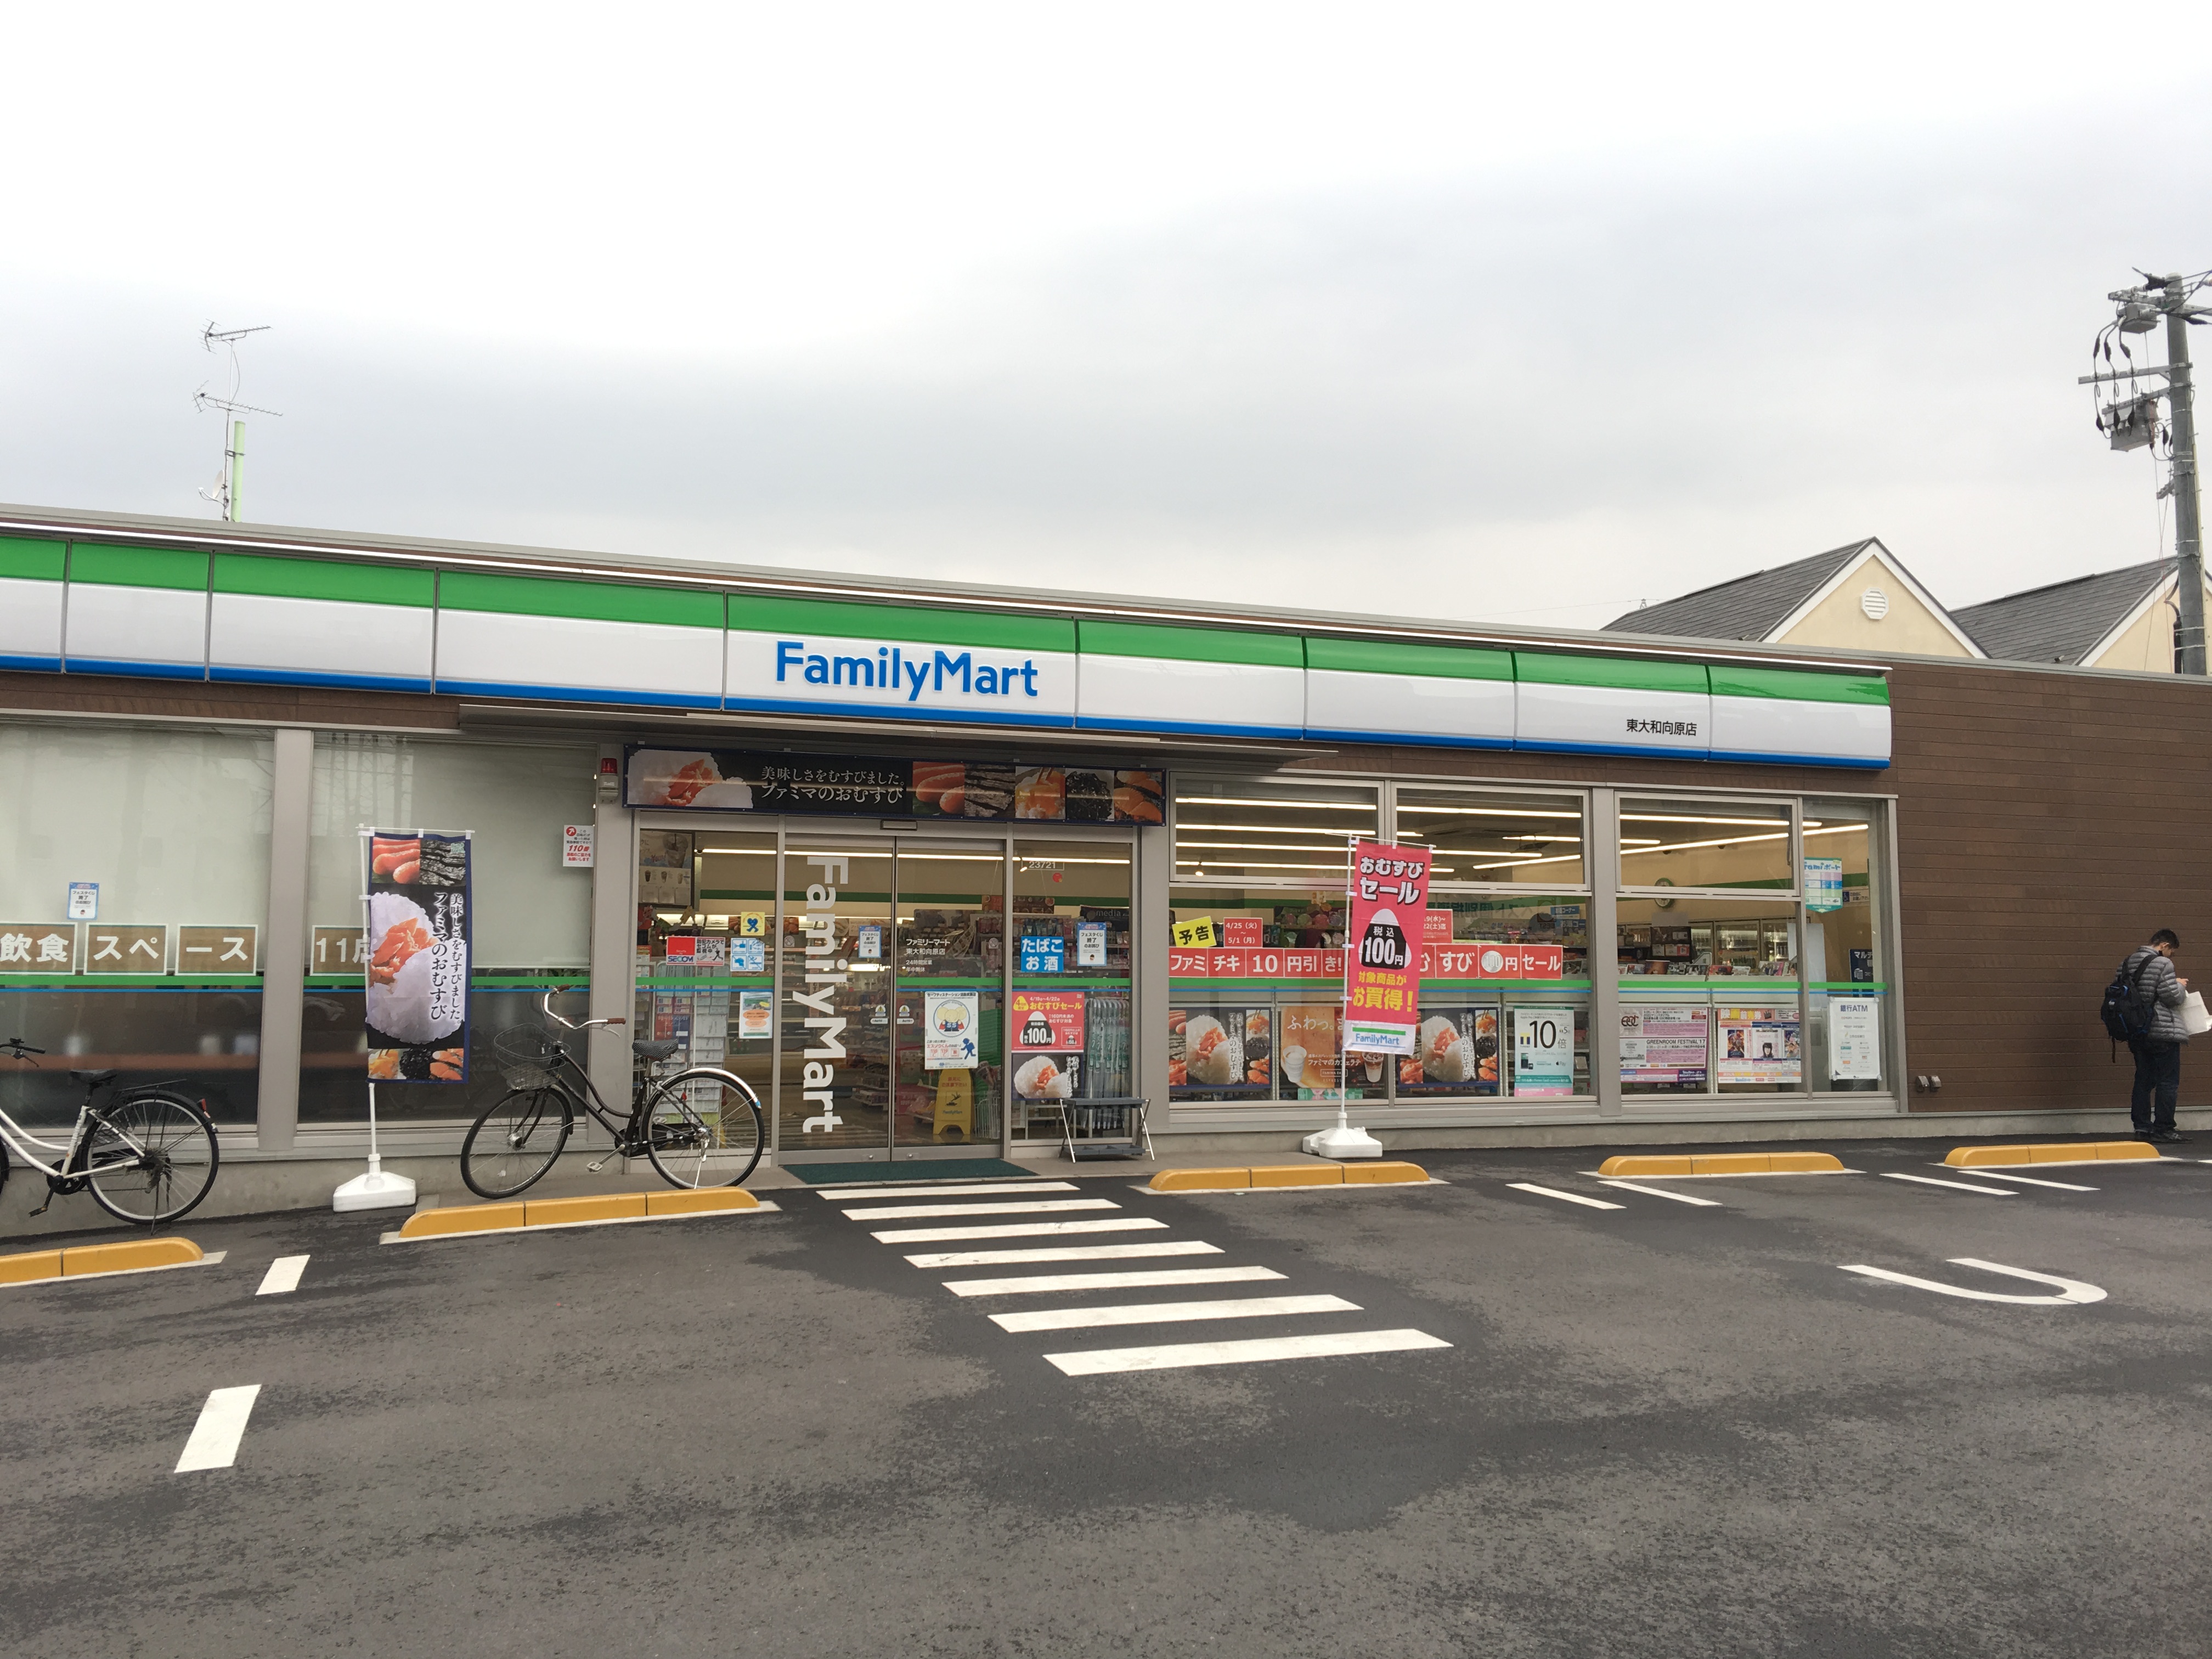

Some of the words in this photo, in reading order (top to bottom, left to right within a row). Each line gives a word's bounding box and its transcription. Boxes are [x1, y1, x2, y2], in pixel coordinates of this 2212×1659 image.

[776, 640, 1039, 702] FamilyMart
[1626, 718, 1697, 736] 東大和向原店
[761, 765, 905, 786] 美味しさをむすびました。
[761, 785, 904, 804] ファミマのおむすび
[1029, 861, 1056, 869] 23721
[1359, 856, 1424, 879] おむすび
[1359, 877, 1421, 905] セール
[1178, 926, 1209, 945] 予告
[1373, 926, 1395, 937] 税込
[1022, 938, 1063, 953] たばこ
[1363, 936, 1403, 966] 100円
[430, 892, 449, 1020] ファミマのおむすび
[449, 893, 464, 1024] 美味しさをむすびました。
[1025, 956, 1059, 971] お酒
[1358, 970, 1407, 986] 対象商品が
[792, 856, 849, 1133] FamilyMart
[1352, 986, 1413, 1012] お買得!
[1029, 1002, 1082, 1010] おむすびセール
[1027, 1028, 1051, 1043] 100円
[1355, 1032, 1400, 1046] FamilyMart
[1530, 1020, 1556, 1048] 10
[1557, 1038, 1567, 1048] 倍
